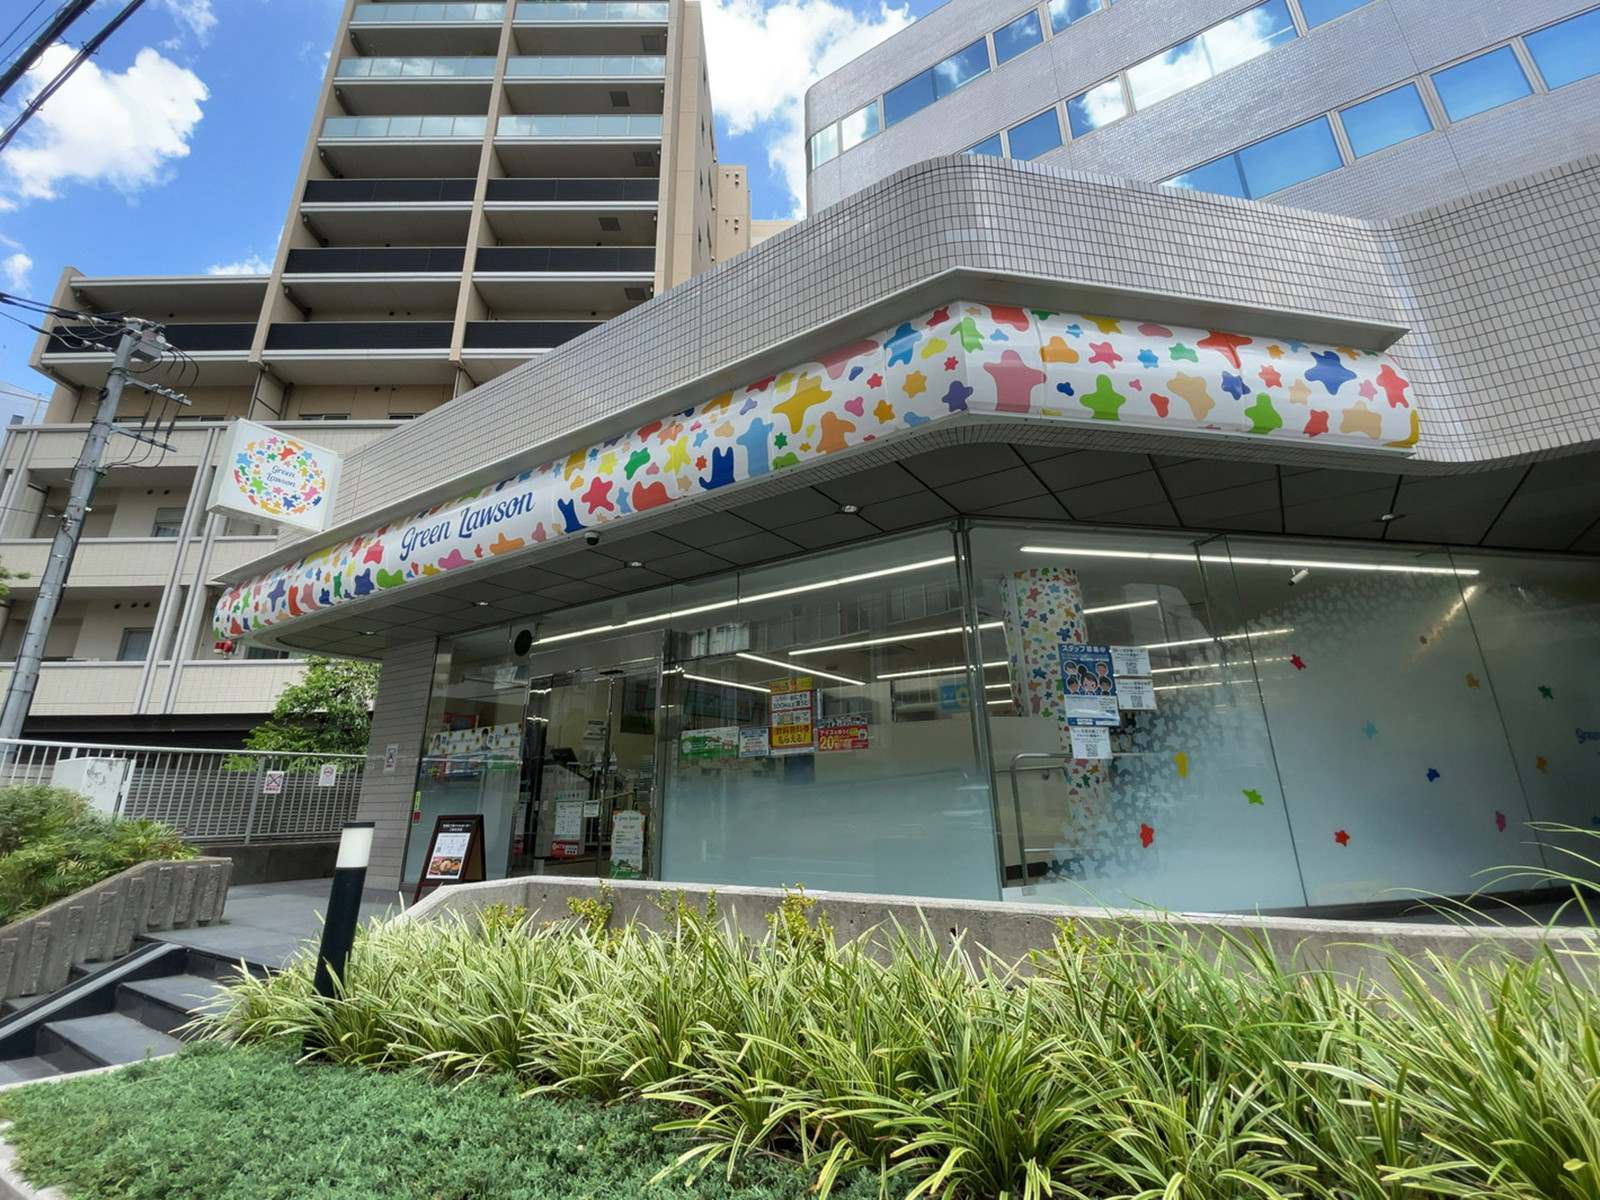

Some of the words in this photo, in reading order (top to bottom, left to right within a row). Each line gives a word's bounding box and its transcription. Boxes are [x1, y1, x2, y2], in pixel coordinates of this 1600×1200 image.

[266, 472, 296, 488] Lawson
[271, 465, 296, 479] Green
[400, 521, 451, 561] Green
[458, 492, 535, 539] Lawson
